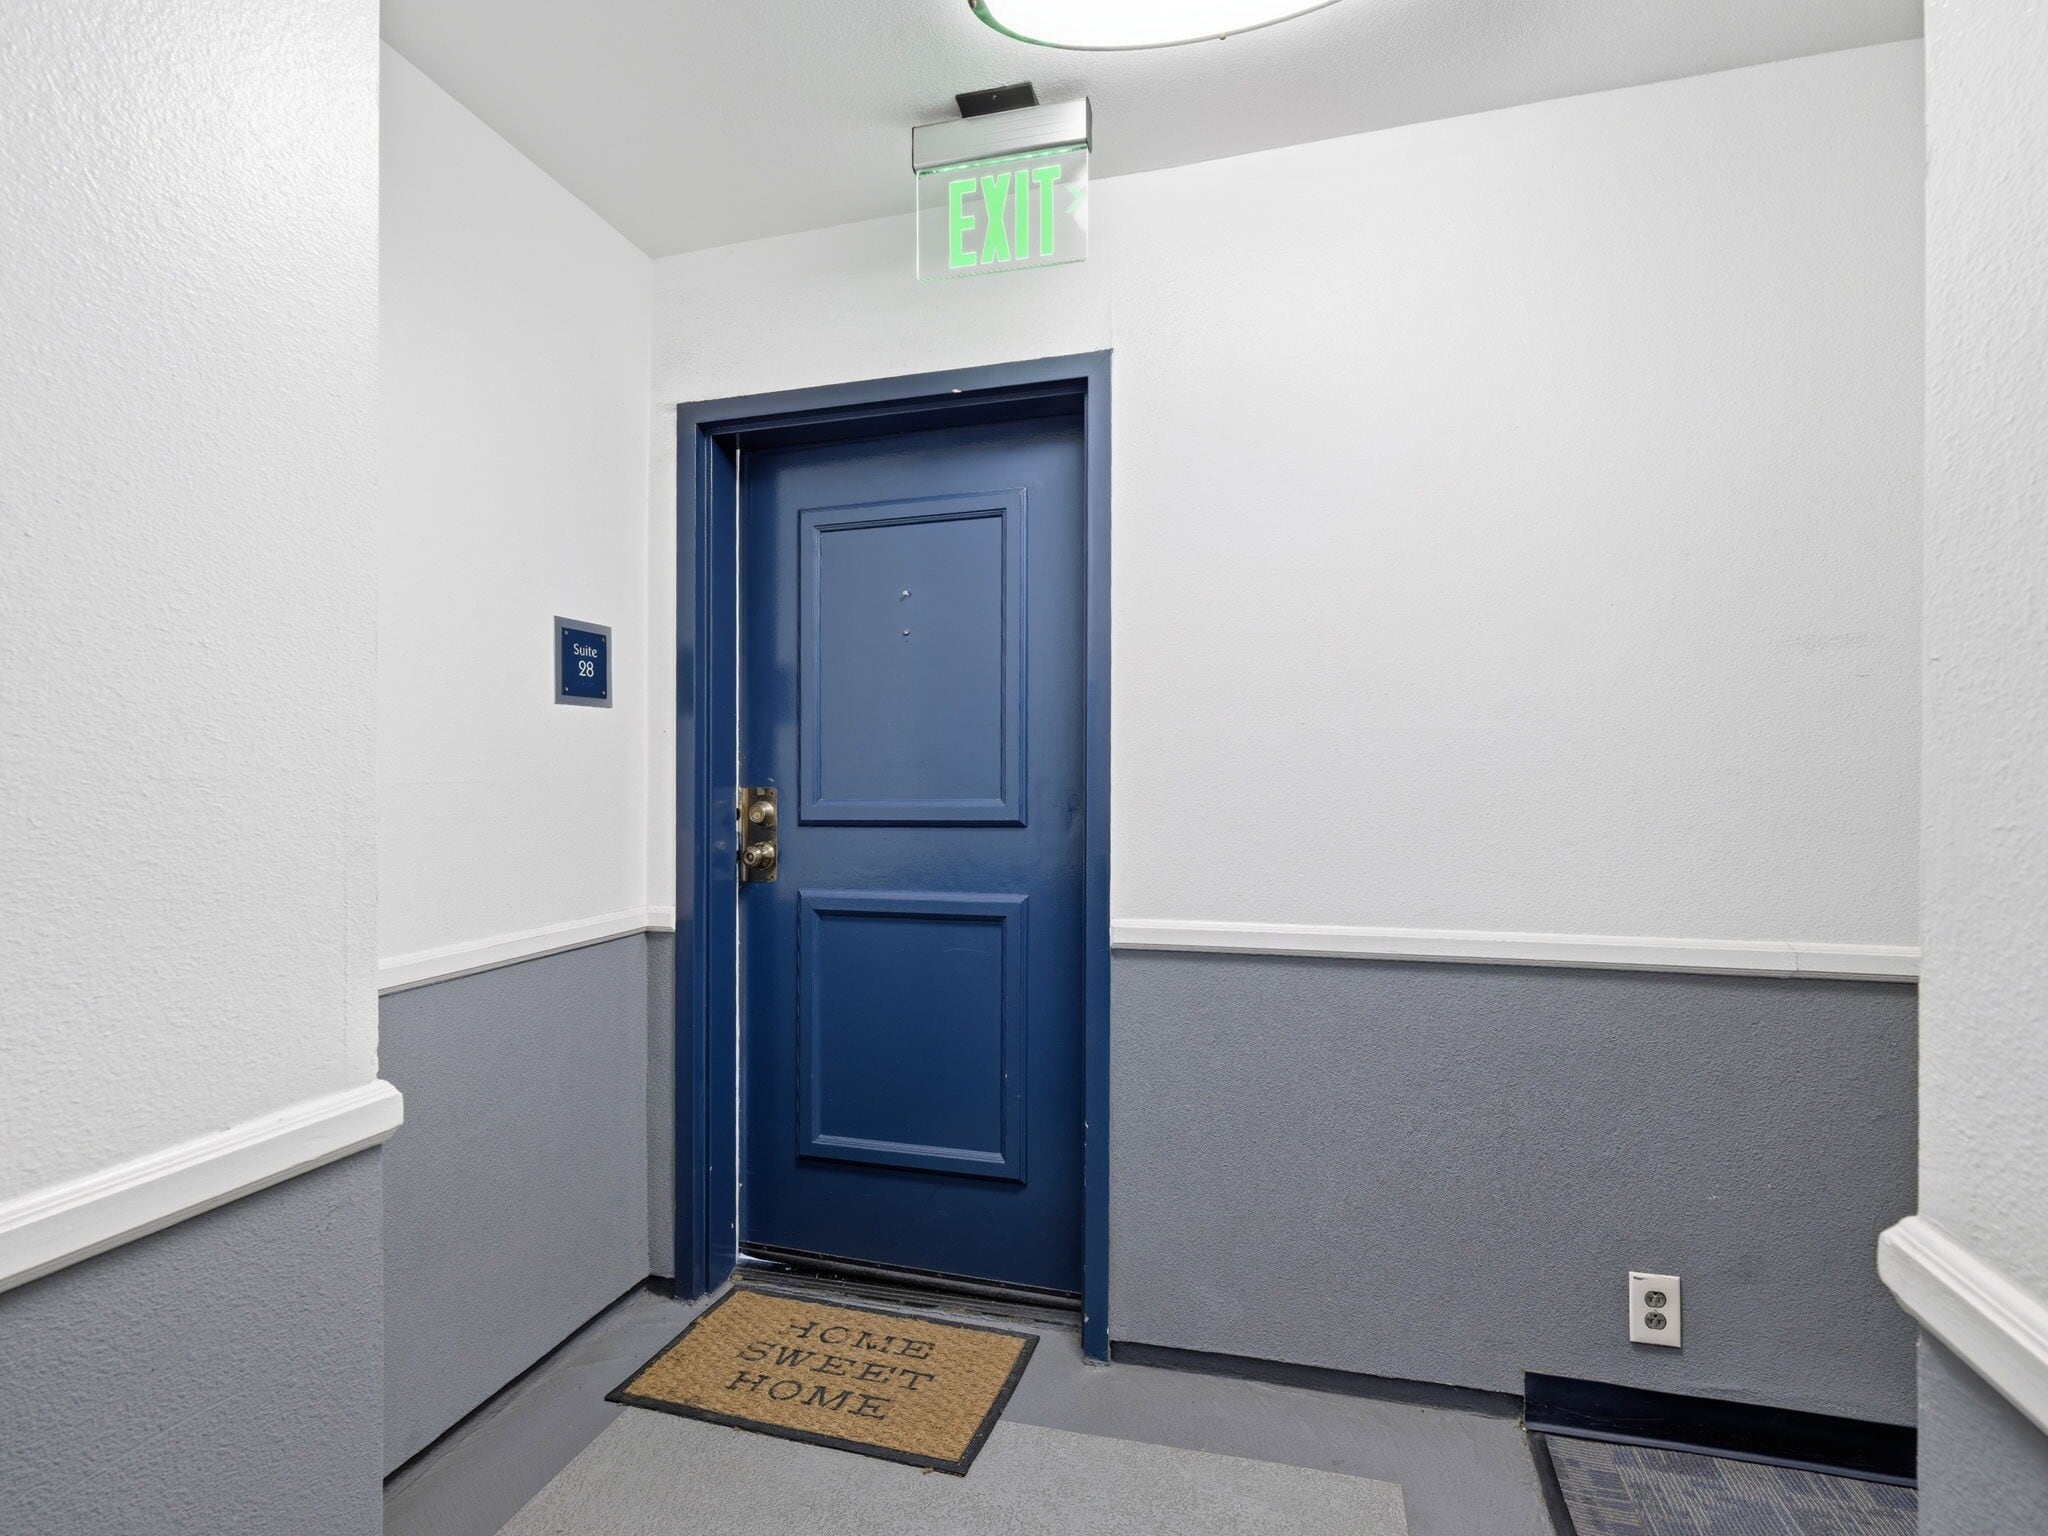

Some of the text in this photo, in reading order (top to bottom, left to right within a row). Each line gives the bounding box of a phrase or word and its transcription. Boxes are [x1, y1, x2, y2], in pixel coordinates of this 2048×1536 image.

[949, 164, 1061, 269] EXIT
[573, 643, 598, 658] Suite
[578, 660, 595, 677] 28
[788, 1321, 936, 1360] HOME
[737, 1340, 935, 1391] SWEET
[726, 1370, 894, 1420] HOME
